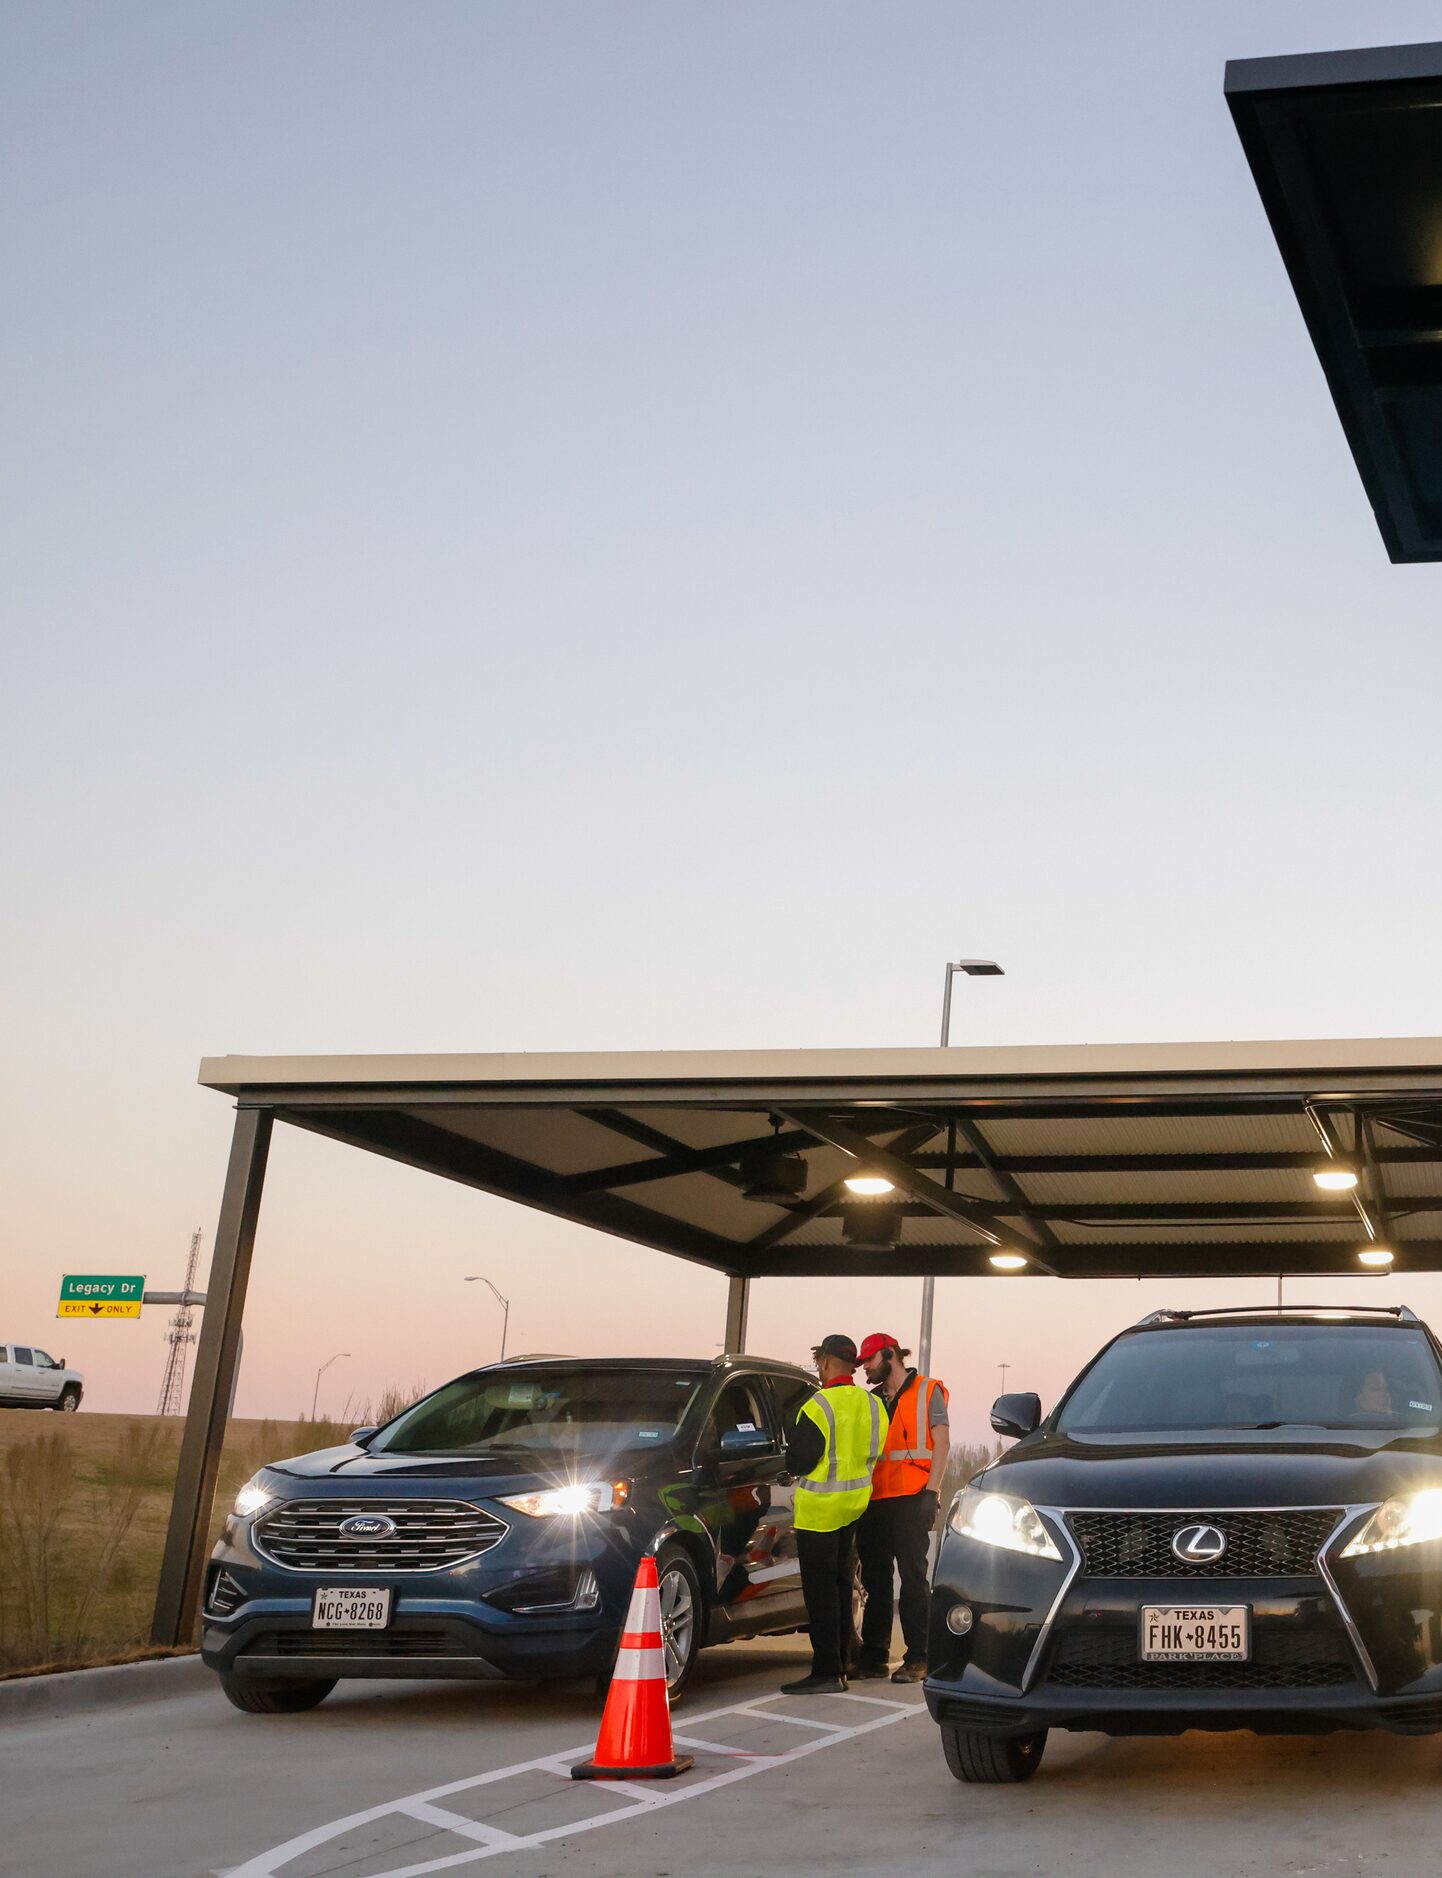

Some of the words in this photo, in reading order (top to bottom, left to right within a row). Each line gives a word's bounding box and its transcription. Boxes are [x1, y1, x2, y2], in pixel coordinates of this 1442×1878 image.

[69, 1282, 115, 1296] Legacy
[121, 1282, 136, 1294] Dr
[65, 1305, 86, 1313] EXIT
[106, 1305, 132, 1313] ONLY
[350, 1520, 381, 1532] Ford
[339, 1591, 367, 1599] TEXAS
[1174, 1610, 1215, 1621] TEXAS
[1150, 1652, 1189, 1661] PARK
[1194, 1652, 1240, 1661] PLACE
